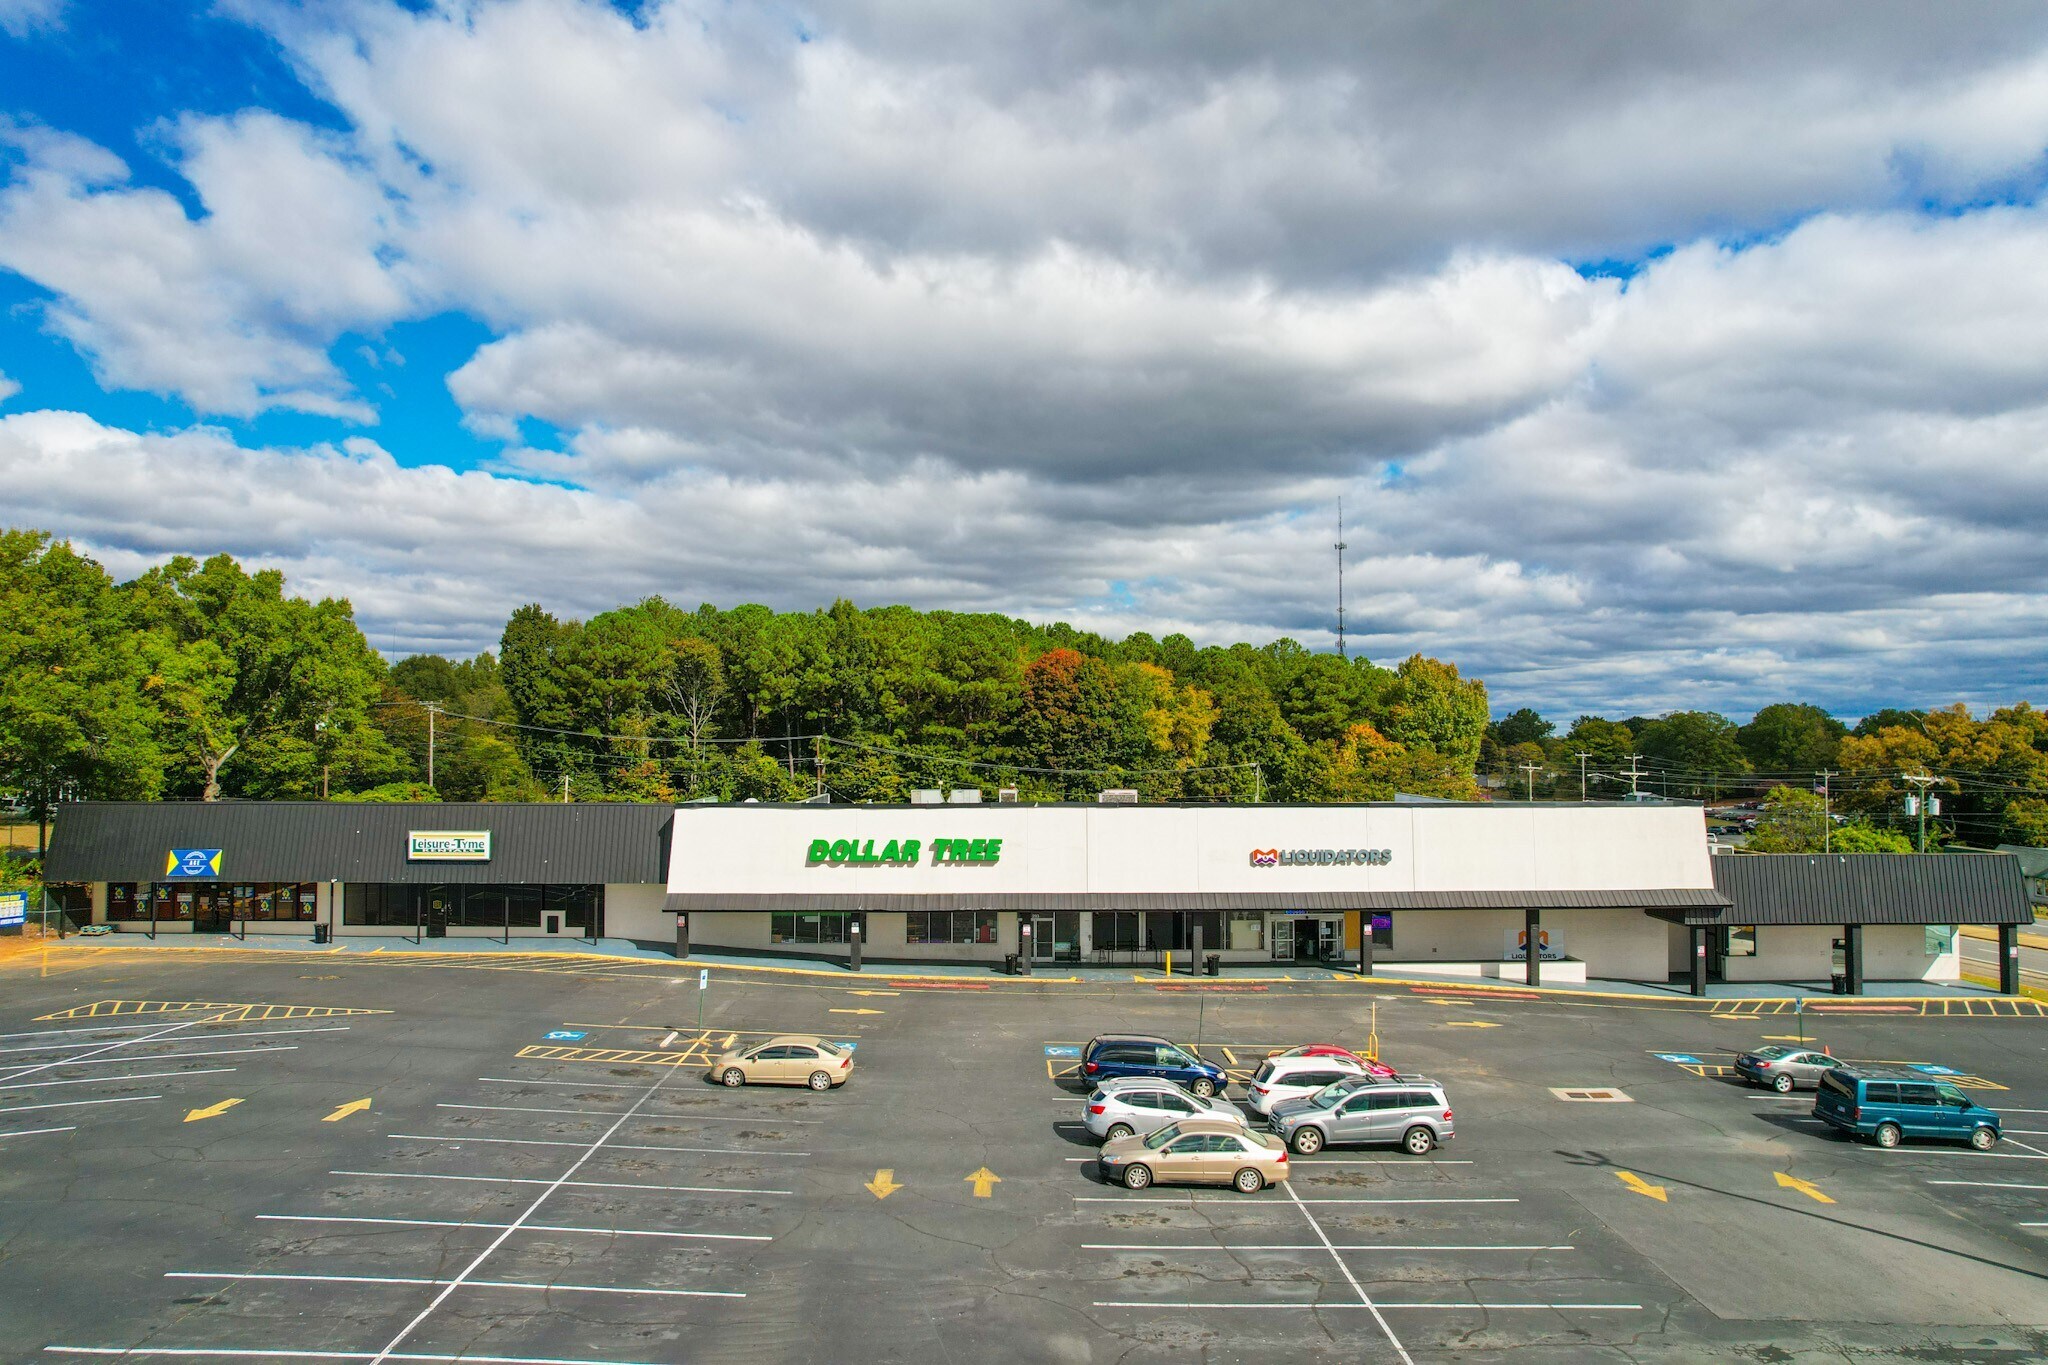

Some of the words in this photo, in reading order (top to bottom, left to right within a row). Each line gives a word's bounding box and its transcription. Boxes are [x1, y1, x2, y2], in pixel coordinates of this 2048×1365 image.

[412, 838, 485, 852] Leisure-Tyme
[809, 839, 921, 862] DOLLAR
[934, 838, 1003, 861] TREE
[1281, 849, 1392, 864] LIQUIDATORS
